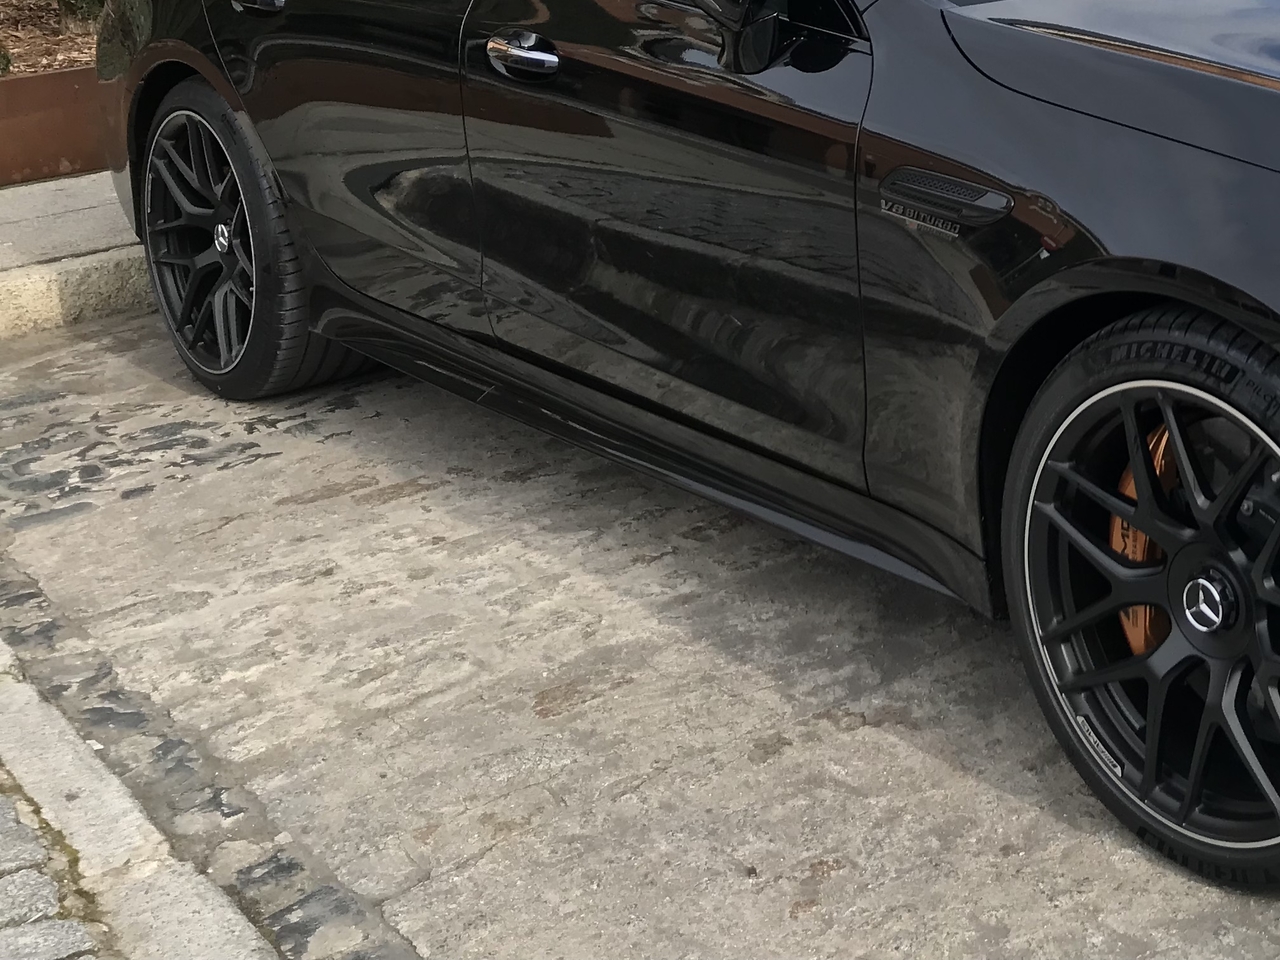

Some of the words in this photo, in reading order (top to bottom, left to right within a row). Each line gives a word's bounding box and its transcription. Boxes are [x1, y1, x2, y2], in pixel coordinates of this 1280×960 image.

[881, 199, 904, 215] V8
[905, 207, 961, 234] BITURBO
[1110, 341, 1232, 378] MICHELIN
